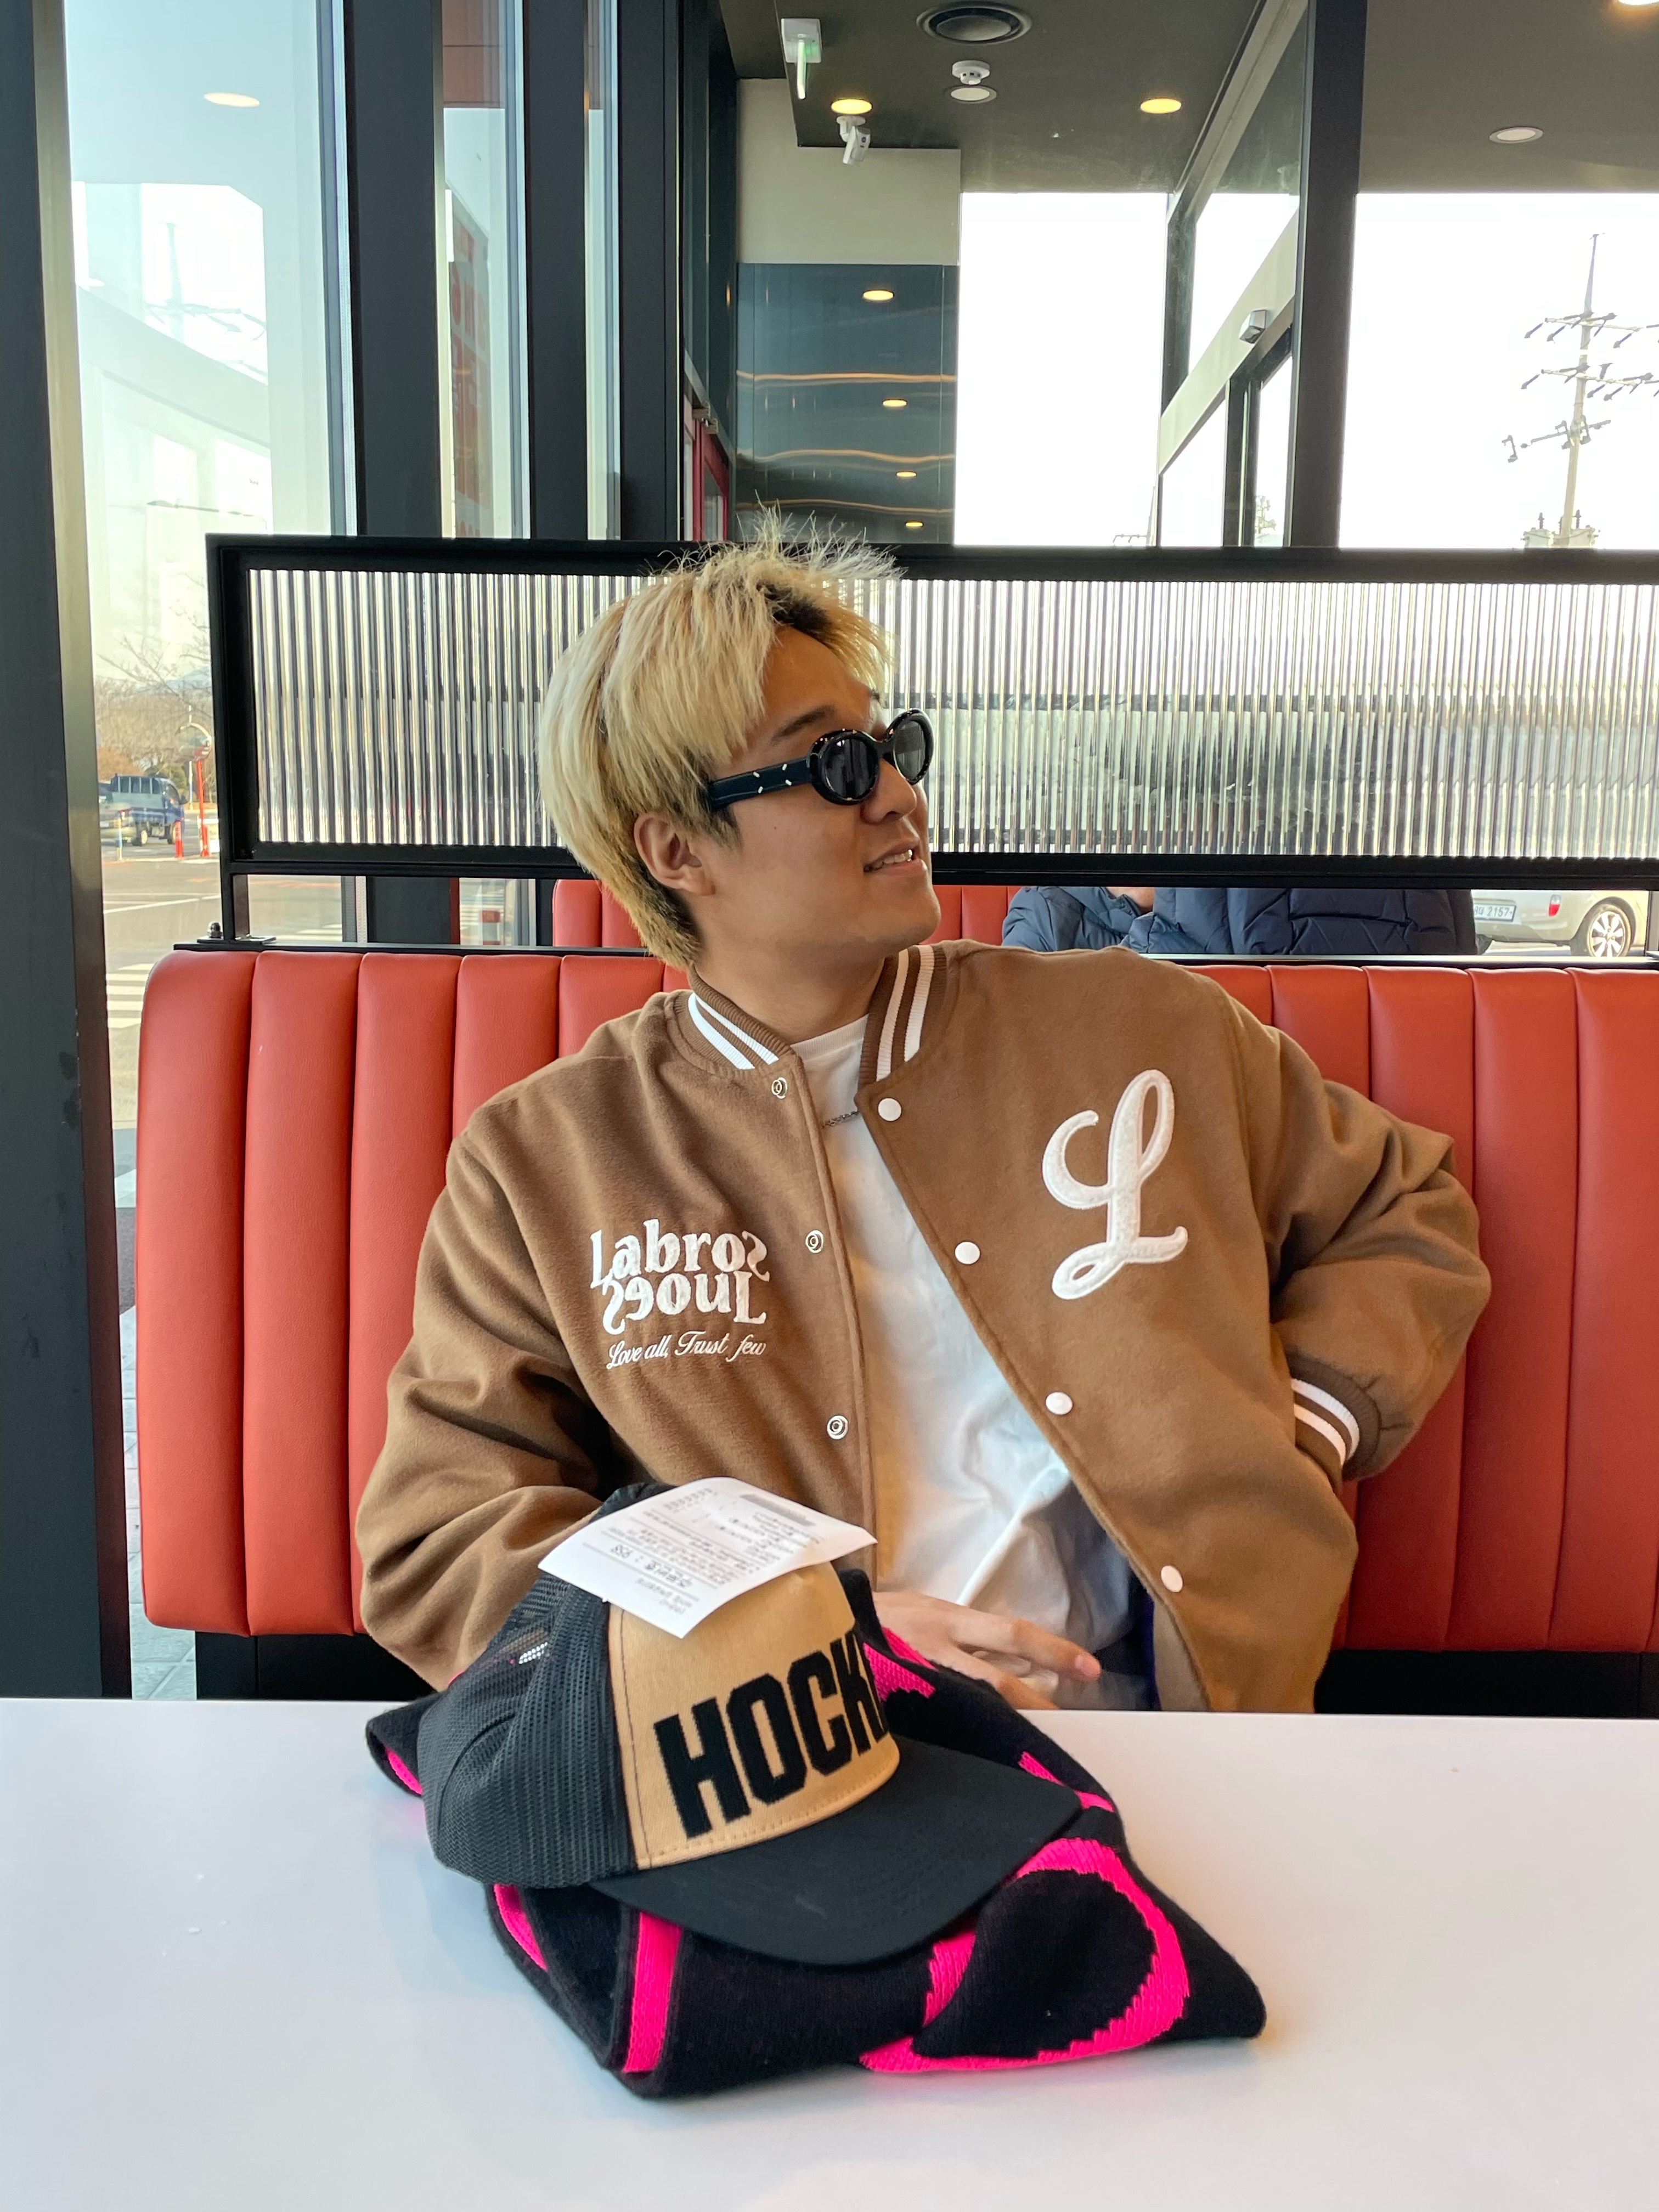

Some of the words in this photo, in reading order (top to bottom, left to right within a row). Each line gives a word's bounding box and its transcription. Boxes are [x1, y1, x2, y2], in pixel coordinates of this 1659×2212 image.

[1487, 906, 1510, 917] 2157
[1042, 1069, 1188, 1300] L
[606, 1340, 642, 1369] Love
[674, 1330, 730, 1356] Trust
[725, 1334, 766, 1362] few
[653, 1629, 885, 1841] HOCK
